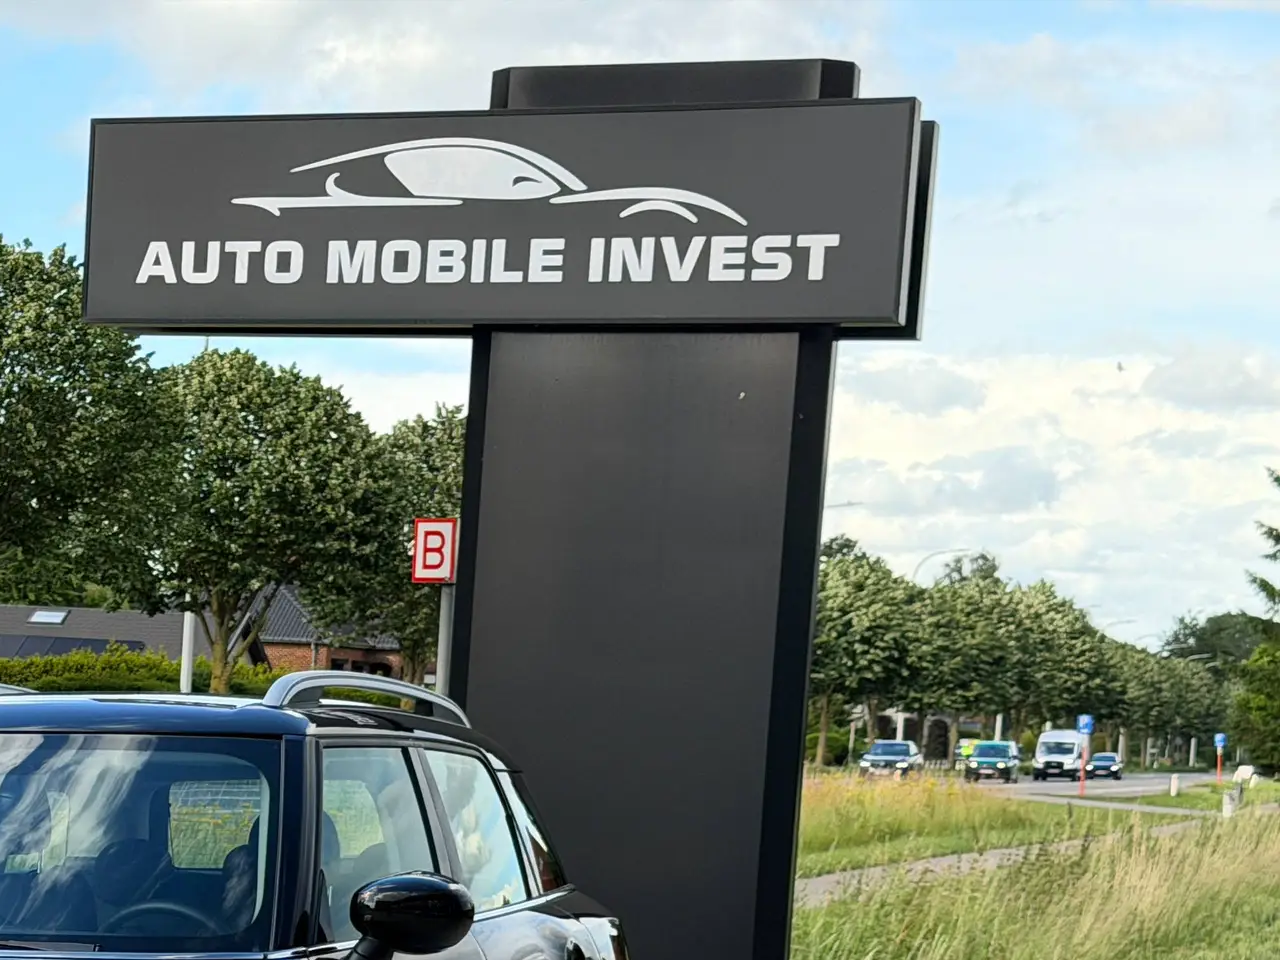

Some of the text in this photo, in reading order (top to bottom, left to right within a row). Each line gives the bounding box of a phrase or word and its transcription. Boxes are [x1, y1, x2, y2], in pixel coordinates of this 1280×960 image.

[135, 233, 841, 284] AUTO MOBILE INVEST
[422, 530, 446, 570] B
